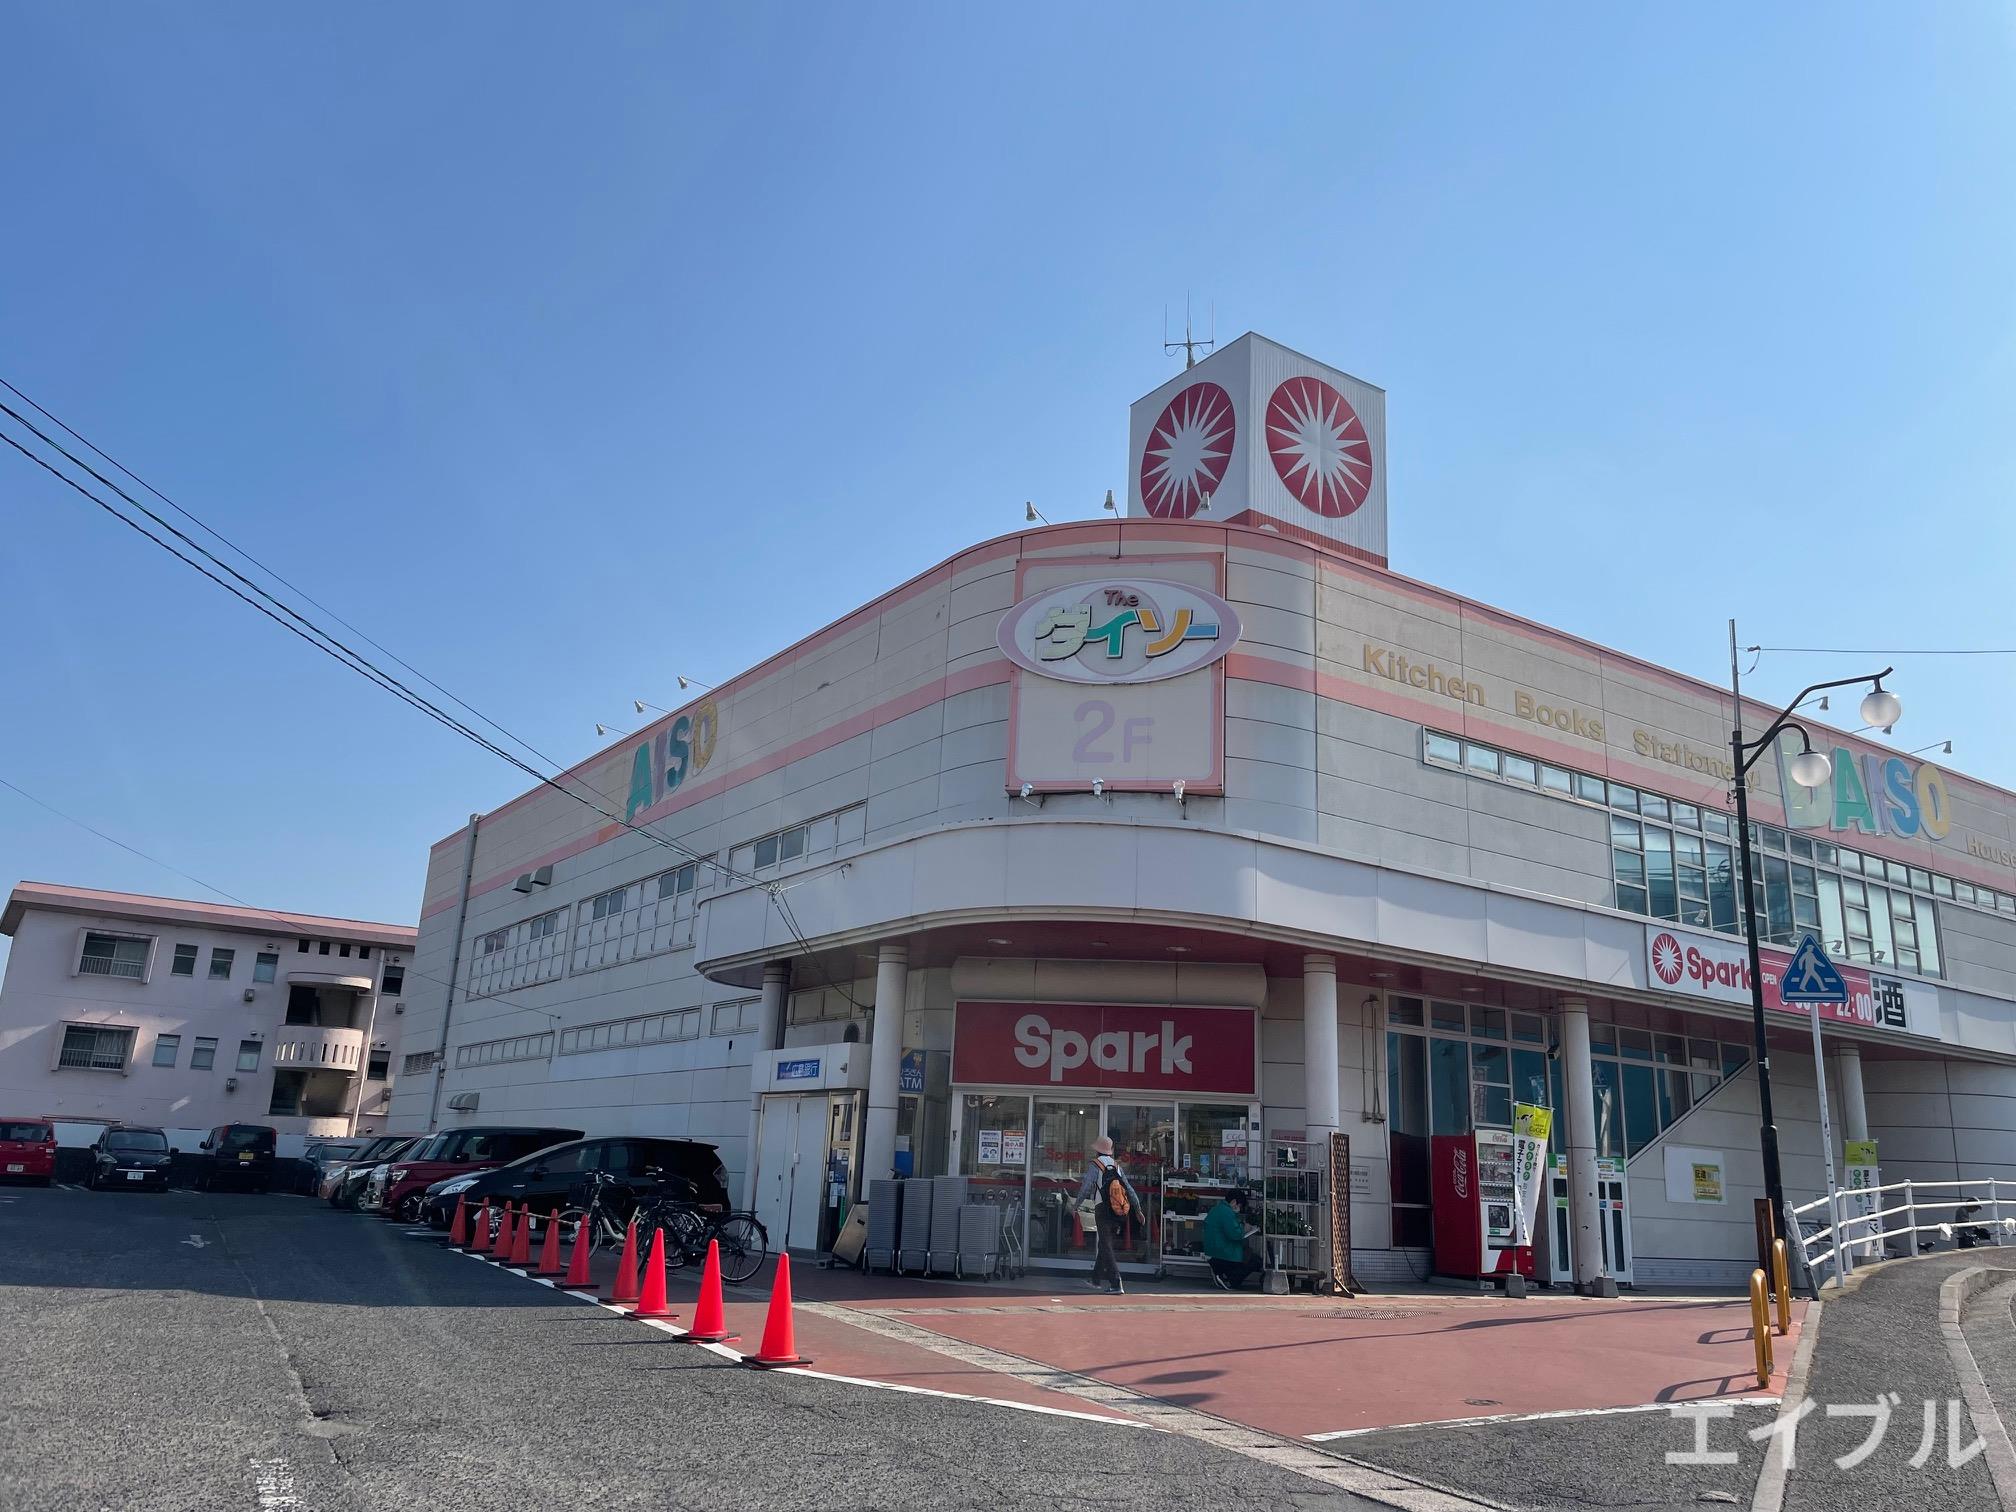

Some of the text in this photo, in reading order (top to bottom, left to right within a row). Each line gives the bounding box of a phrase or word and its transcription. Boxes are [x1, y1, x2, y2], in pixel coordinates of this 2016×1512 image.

[1104, 590, 1139, 607] The
[1035, 603, 1219, 661] ダイソー
[1072, 700, 1154, 764] 2F
[1363, 643, 1760, 793] Kitchen Books Stationey
[1774, 730, 1949, 841] DAISO
[1762, 971, 1777, 985] OPEN
[1873, 976, 1906, 1028] 酒
[1014, 1014, 1192, 1081] Spark
